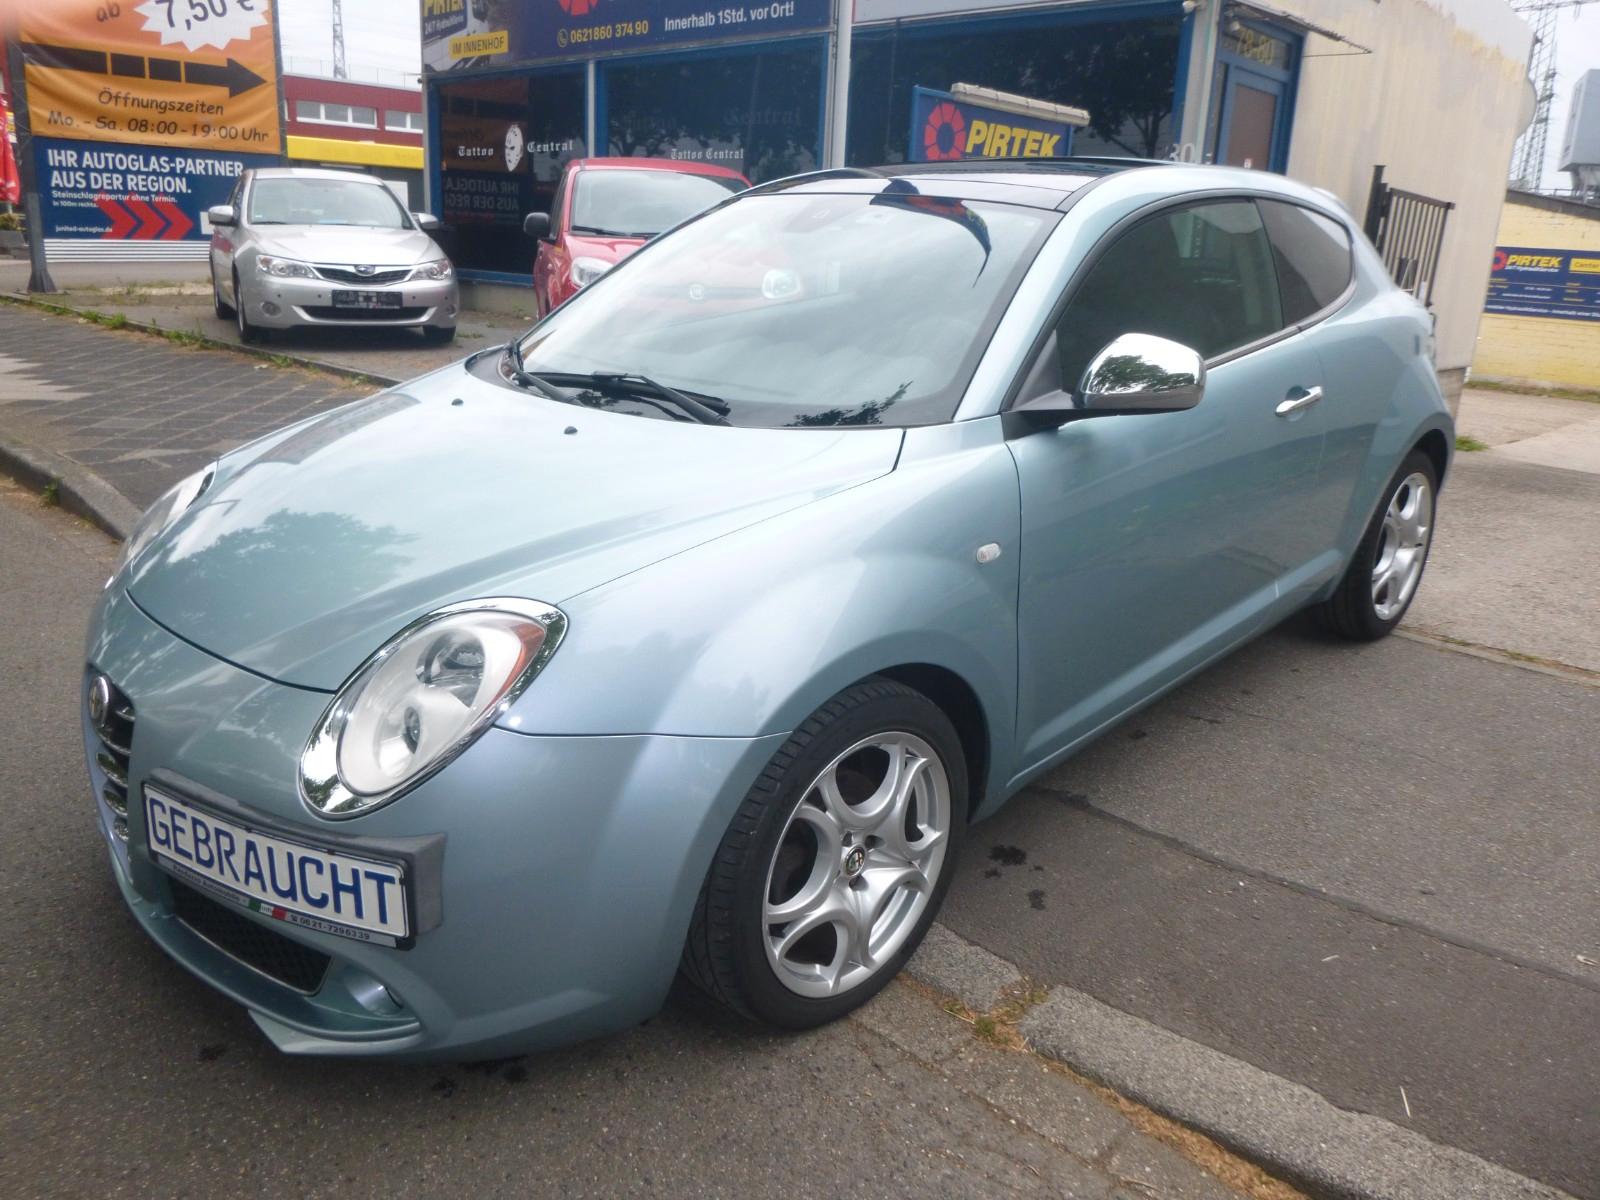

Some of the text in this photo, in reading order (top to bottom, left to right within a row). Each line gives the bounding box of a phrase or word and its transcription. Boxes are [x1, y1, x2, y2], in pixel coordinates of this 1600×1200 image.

[96, 4, 121, 22] ab
[155, 0, 227, 30] 7,50
[664, 11, 716, 32] Innerhalb
[751, 7, 769, 21] vor
[771, 1, 795, 18] Ort!
[452, 36, 505, 54] IM INNENHOF
[98, 87, 224, 116] Öffnungszeiten
[47, 110, 80, 129] Mo.
[241, 126, 269, 143] Uhr
[965, 119, 1061, 158] PIRTEK
[458, 138, 574, 157] Tattoo Central
[671, 147, 744, 160] Tattoo Central
[47, 149, 244, 177] IHR AUTOGLAS-PARTNER
[51, 170, 192, 194] AUS DER REGION.
[130, 193, 150, 203] ohne
[151, 193, 178, 204] Termin.
[1506, 254, 1563, 268] PIRTEK
[148, 796, 396, 926] GEBRAUCHT
